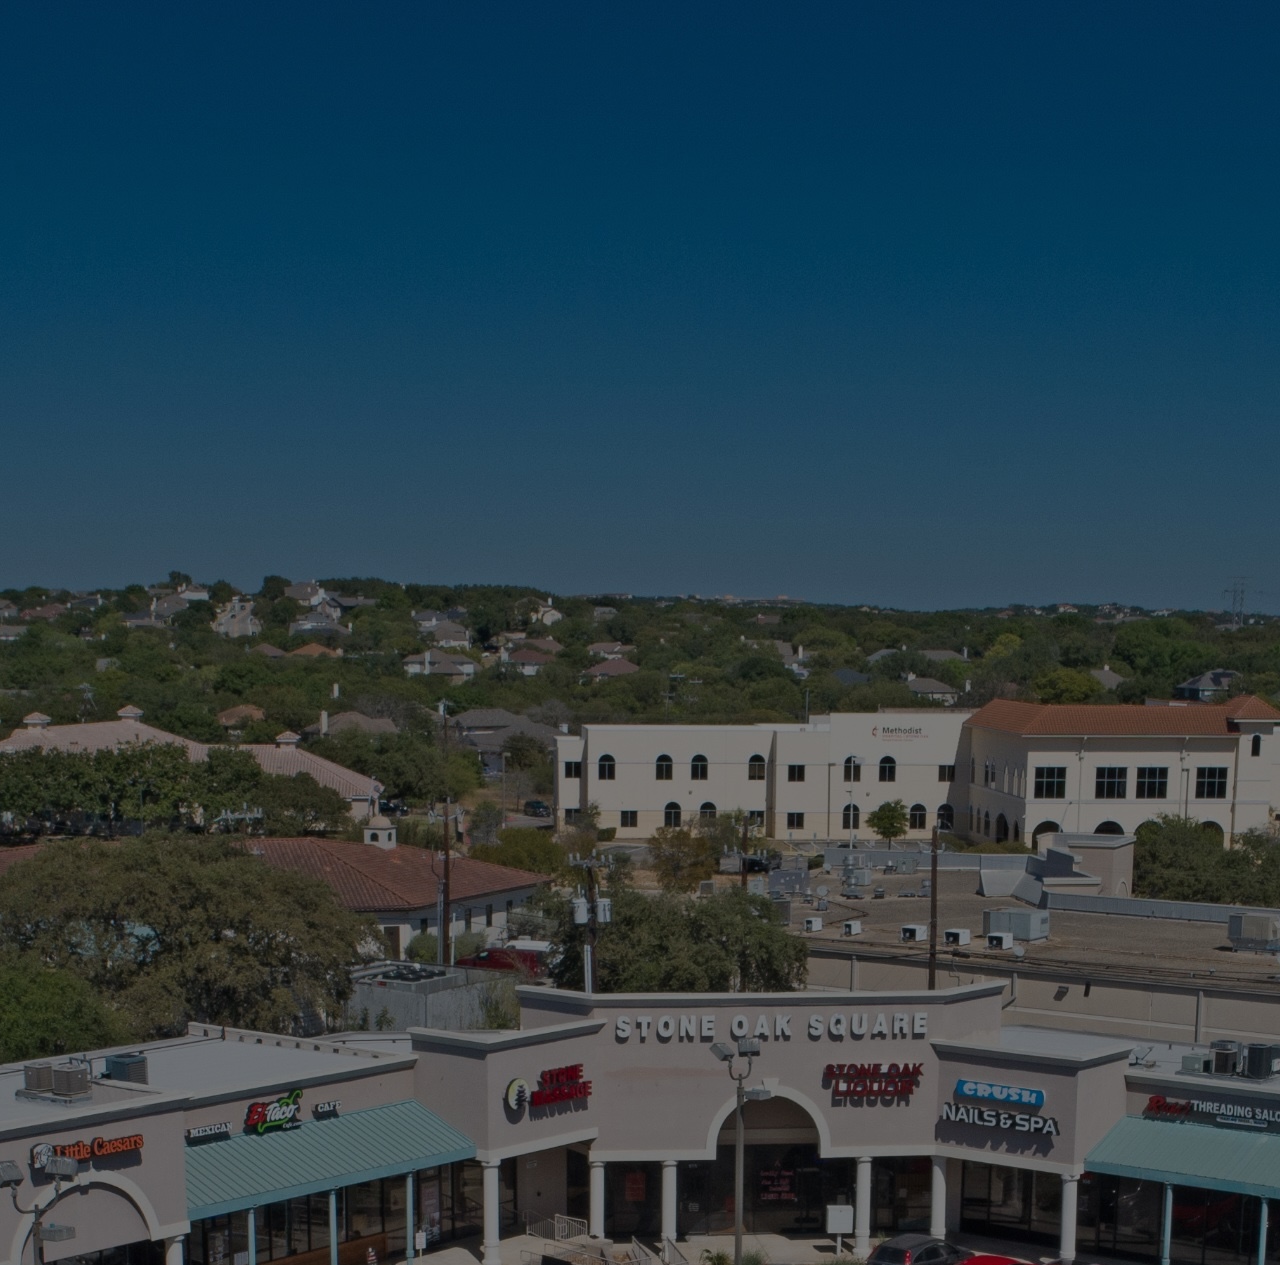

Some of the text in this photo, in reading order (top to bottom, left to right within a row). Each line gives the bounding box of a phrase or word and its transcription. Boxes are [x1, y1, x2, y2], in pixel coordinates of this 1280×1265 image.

[616, 1012, 928, 1038] STONE OAK SQUARE
[542, 1064, 583, 1087] STONE
[825, 1063, 924, 1079] STONE OAK
[531, 1081, 592, 1106] MASSAGE
[835, 1079, 915, 1097] LIQUOR
[963, 1082, 1037, 1104] CRUSH
[265, 1102, 298, 1122] Taco
[943, 1103, 1057, 1136] NAILS & SPA
[1190, 1099, 1253, 1118] THREADING
[190, 1122, 233, 1138] MEXICAN
[55, 1135, 143, 1159] Little Caesars
